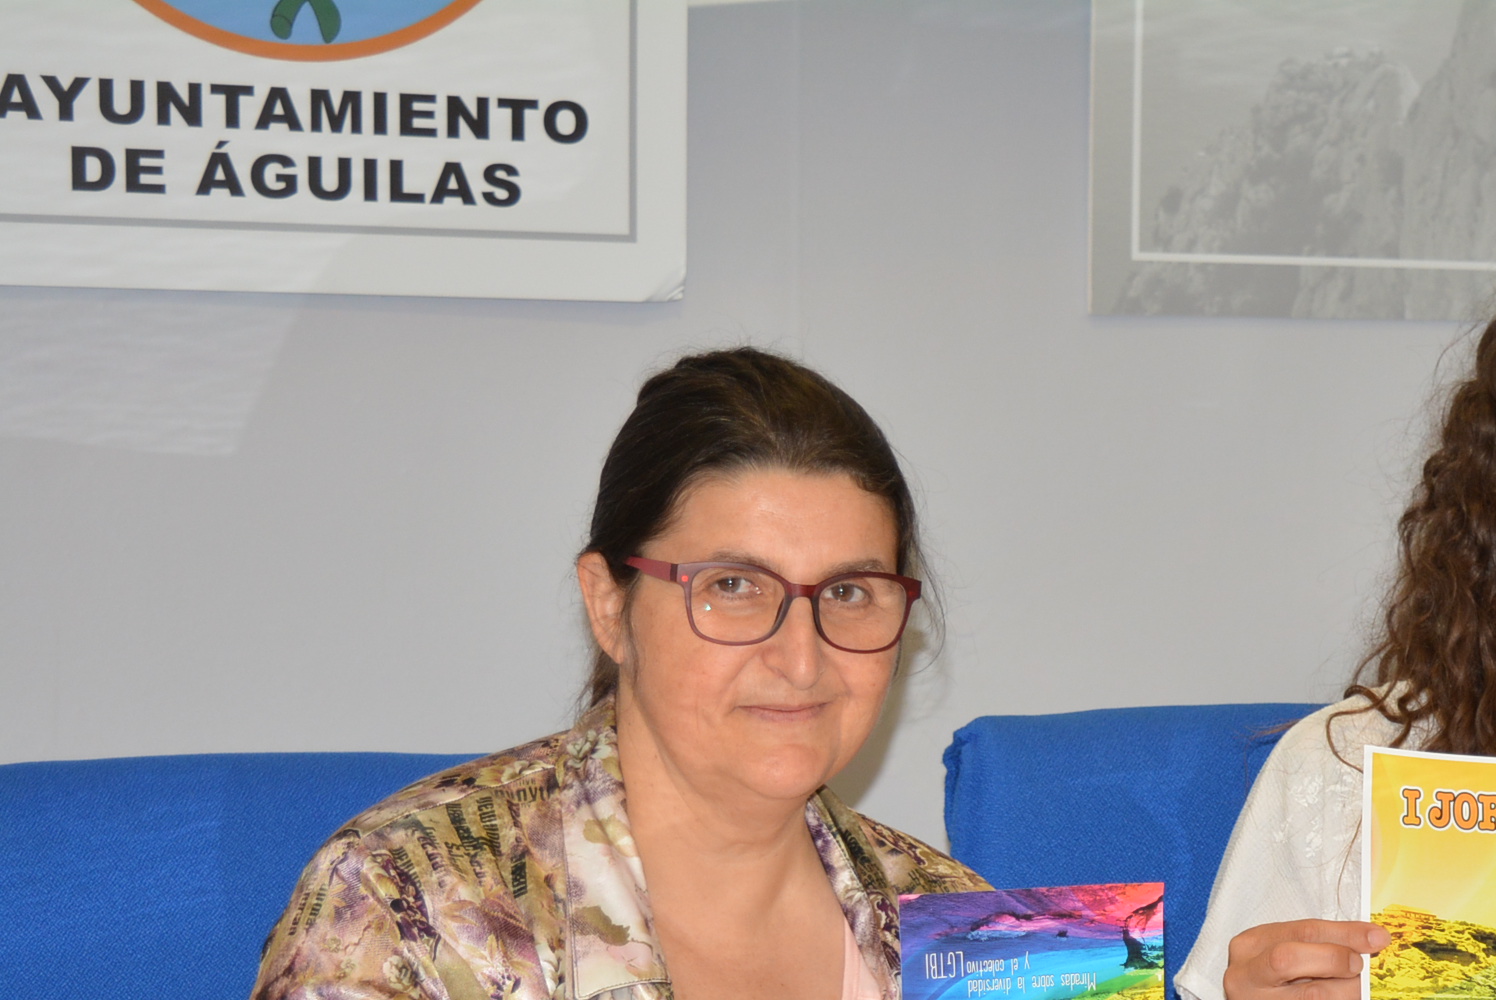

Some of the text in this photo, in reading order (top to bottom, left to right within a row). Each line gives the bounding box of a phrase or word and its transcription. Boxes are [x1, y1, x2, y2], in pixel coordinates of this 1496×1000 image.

[0, 72, 590, 145] AYUNTAMIENTO
[70, 140, 522, 208] DE ÁGUILAS
[1401, 788, 1422, 827] I
[925, 951, 1031, 980] y el colectivo LGTBI
[967, 972, 1097, 998] Miradas sobre la diversidad
